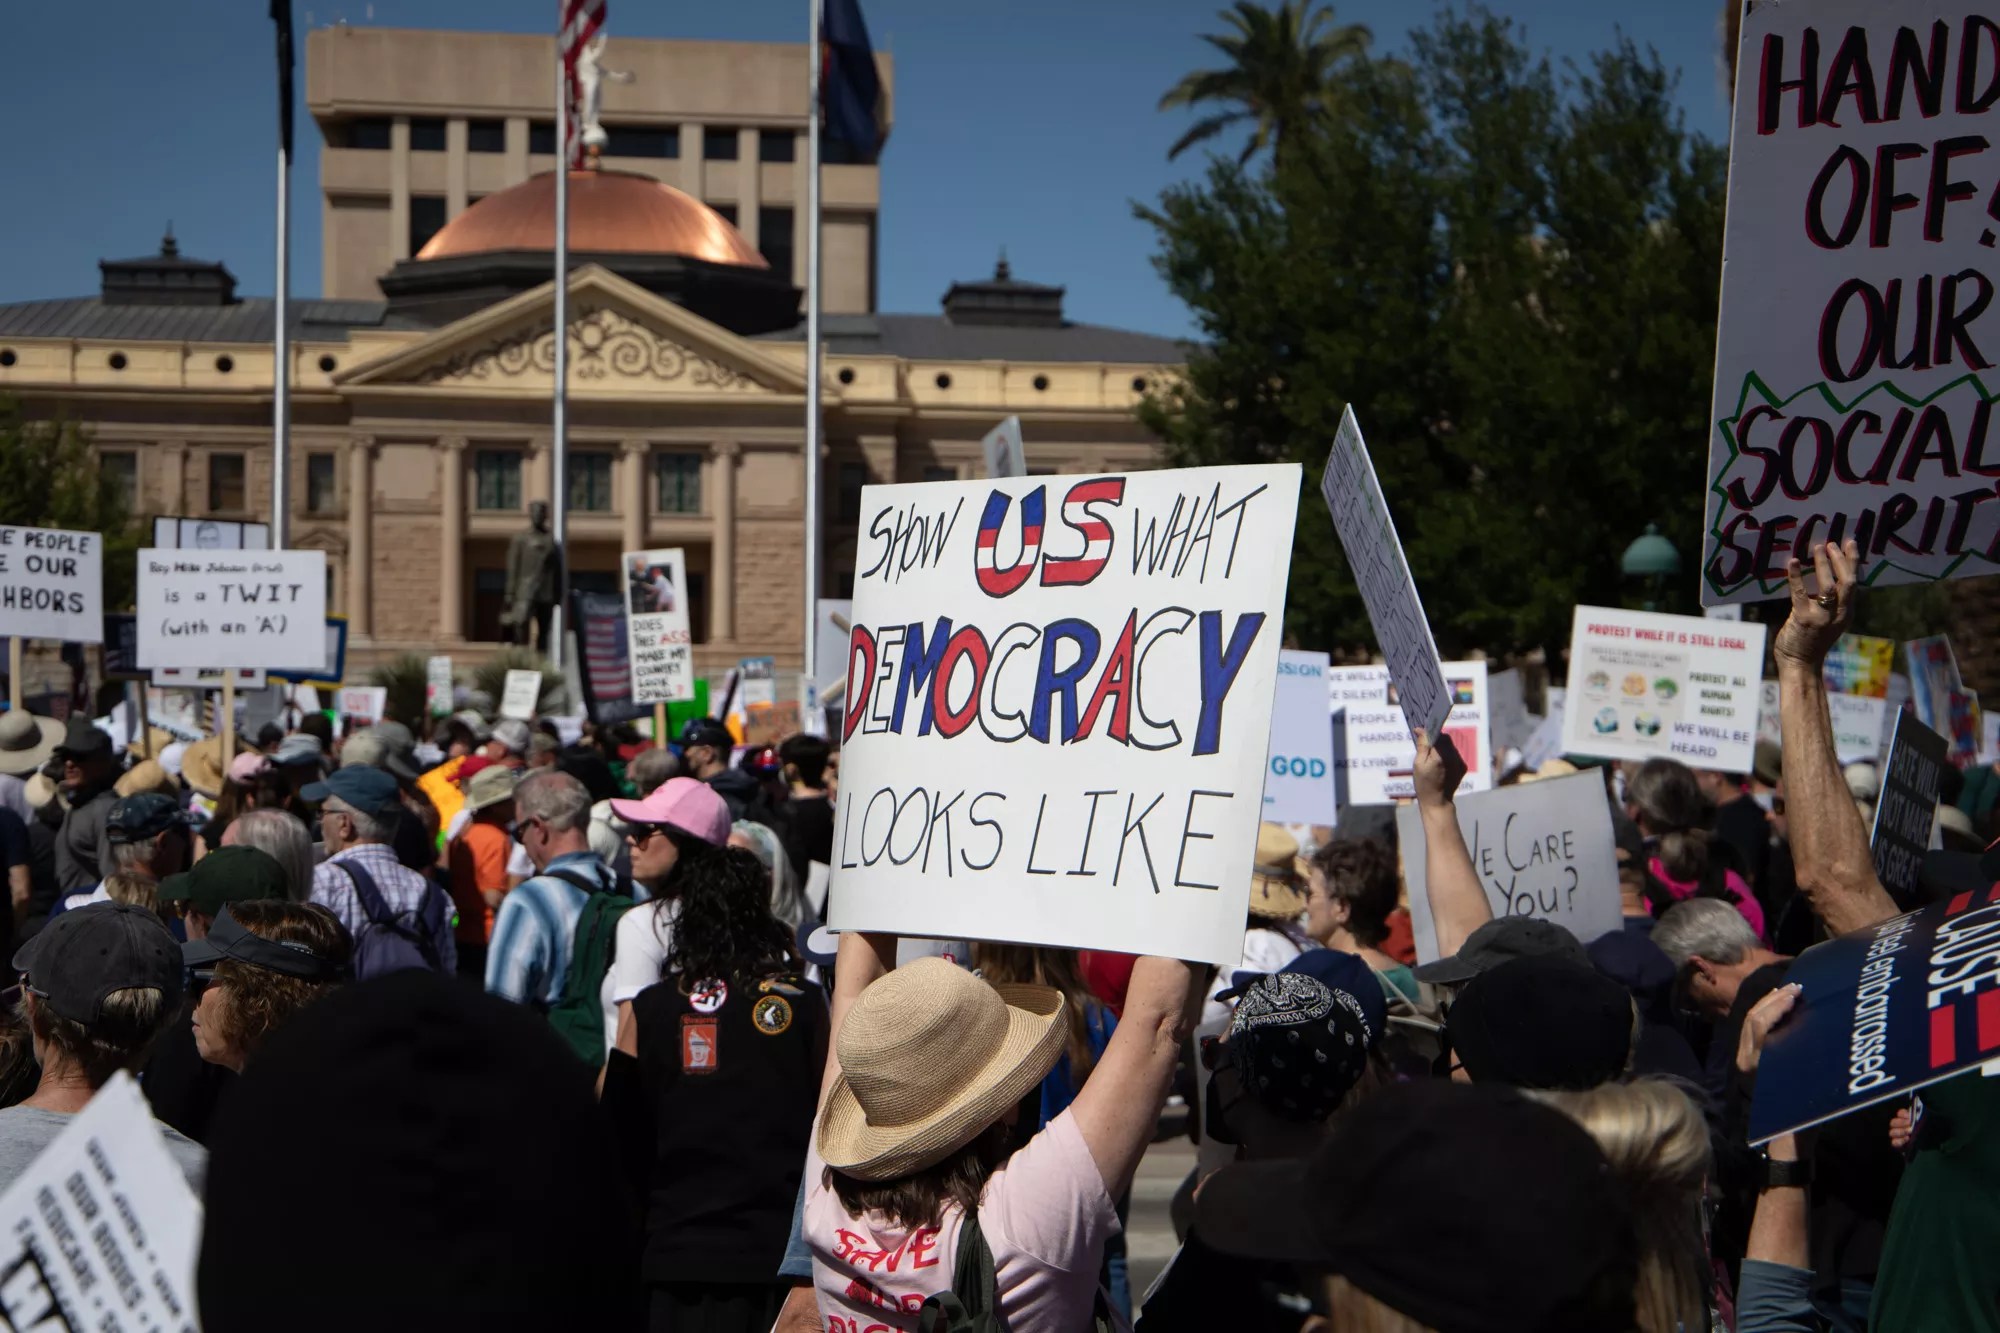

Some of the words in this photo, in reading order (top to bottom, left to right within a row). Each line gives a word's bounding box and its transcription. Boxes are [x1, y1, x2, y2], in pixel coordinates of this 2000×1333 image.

[1758, 15, 2000, 135] HAND
[1818, 267, 1996, 383] OUR
[1727, 400, 2000, 511] SOCIAL
[25, 531, 90, 554] PEOPLE
[861, 496, 965, 584] SHOW
[974, 477, 1127, 598] US
[1131, 481, 1268, 584] WHAT
[1709, 479, 2000, 587] SECURIT
[25, 555, 77, 576] OUR
[0, 584, 84, 613] HBORS
[164, 587, 180, 602] is
[195, 591, 206, 602] a
[219, 583, 303, 602] TWIT
[161, 618, 209, 637] (with
[220, 622, 246, 634] an
[633, 618, 663, 633] DOES
[660, 630, 690, 646] ASS
[1587, 622, 1631, 638] PROTEST
[1635, 627, 1664, 642] WHILE
[1666, 631, 1675, 643] IT
[1678, 633, 1687, 644] IS
[1691, 634, 1716, 647] STILL
[1718, 638, 1746, 651] LEGAL
[1277, 661, 1322, 677] SSION
[1346, 671, 1376, 681] WILL
[842, 605, 1267, 756] DEMOCRACY
[1732, 676, 1746, 688] ALL
[1342, 688, 1384, 699] SILENT
[1350, 713, 1397, 724] PEOPLE
[1448, 711, 1481, 721] GAIN
[1359, 731, 1404, 743] HANDS
[1674, 721, 1696, 735] WE
[1698, 725, 1729, 740] WILL
[1732, 730, 1750, 743] BE
[1671, 740, 1717, 758] HEARD
[1270, 755, 1327, 778] GOD
[1362, 756, 1398, 768] LYING
[1383, 782, 1413, 793] WRO
[841, 786, 1006, 878] LOOKS
[1026, 789, 1235, 894] LIKE
[1848, 956, 1902, 1095] embarrassed
[832, 1224, 943, 1273] SAVE
